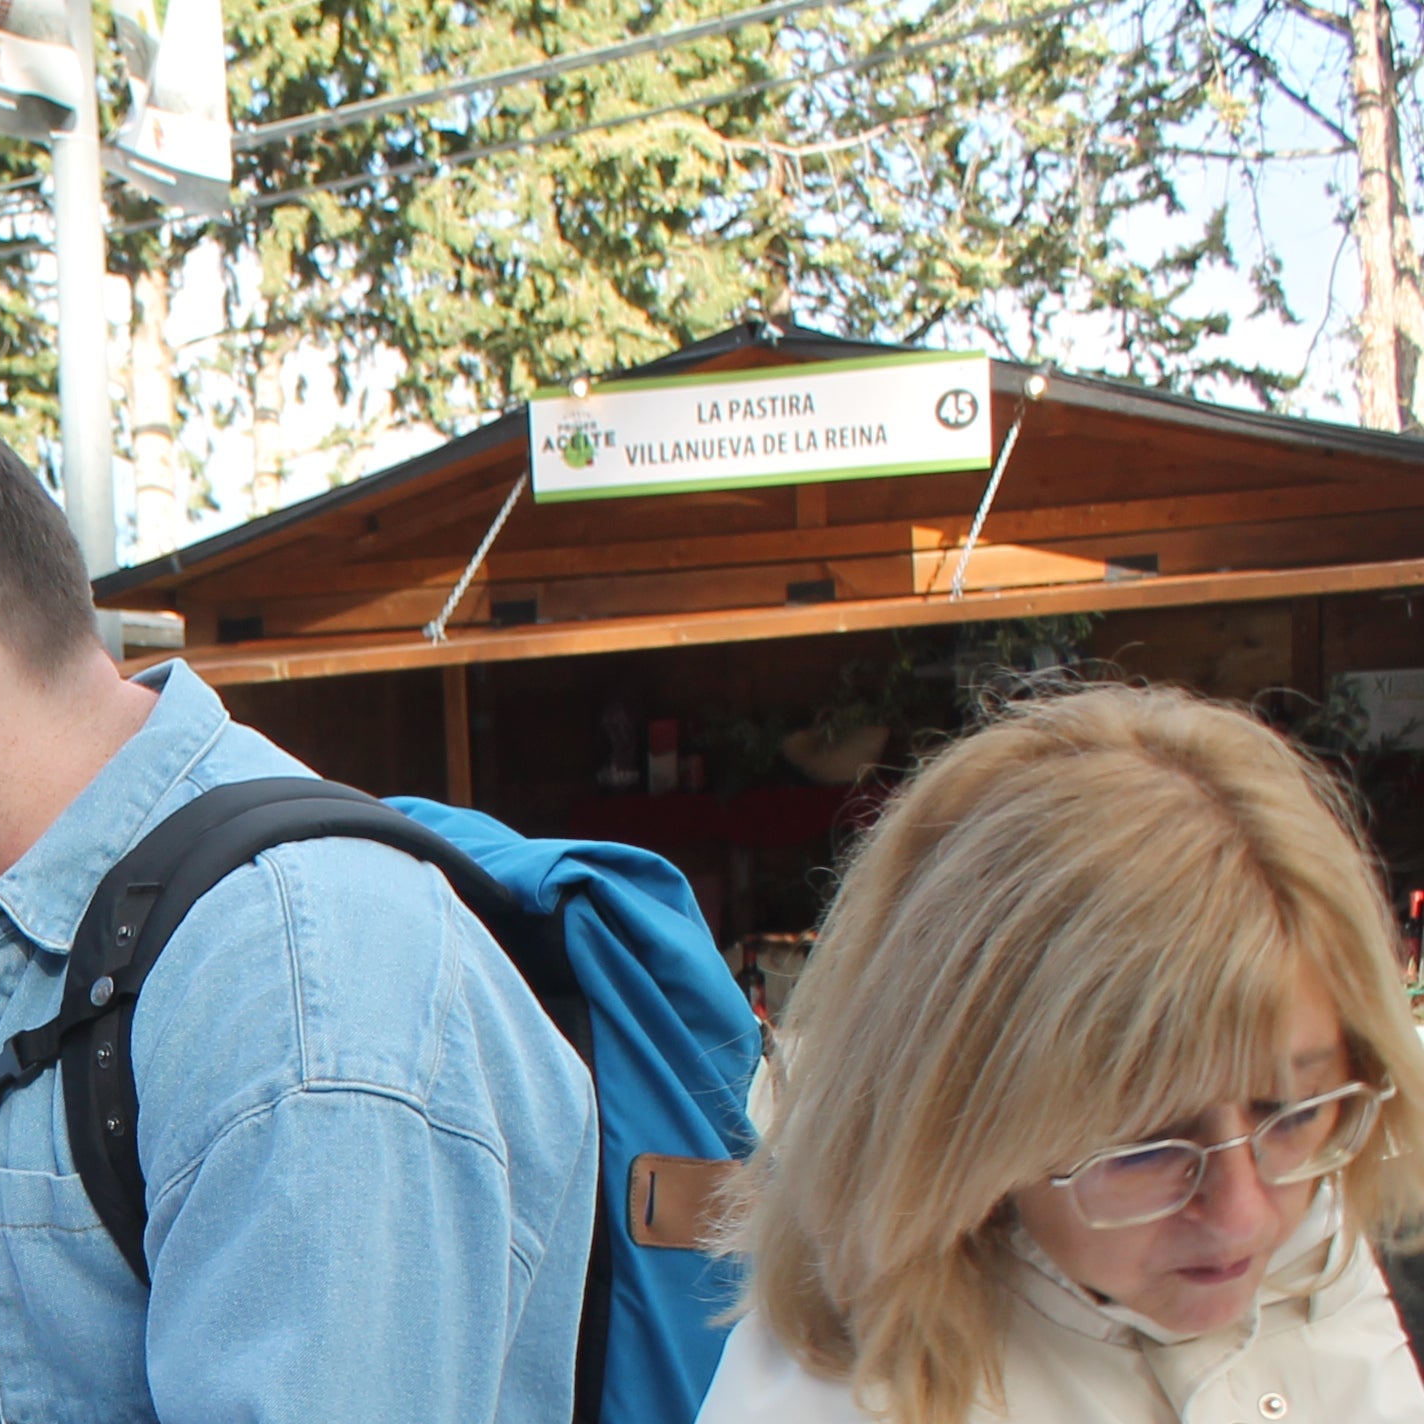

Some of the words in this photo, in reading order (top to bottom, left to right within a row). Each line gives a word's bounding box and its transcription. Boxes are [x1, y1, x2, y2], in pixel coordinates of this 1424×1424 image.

[696, 400, 722, 424] LA
[728, 392, 816, 420] PASTIRA
[938, 390, 975, 426] 45
[625, 435, 757, 467] VILLANUEVA
[763, 432, 789, 455] DE
[794, 429, 819, 453] LA
[825, 424, 888, 450] REINA
